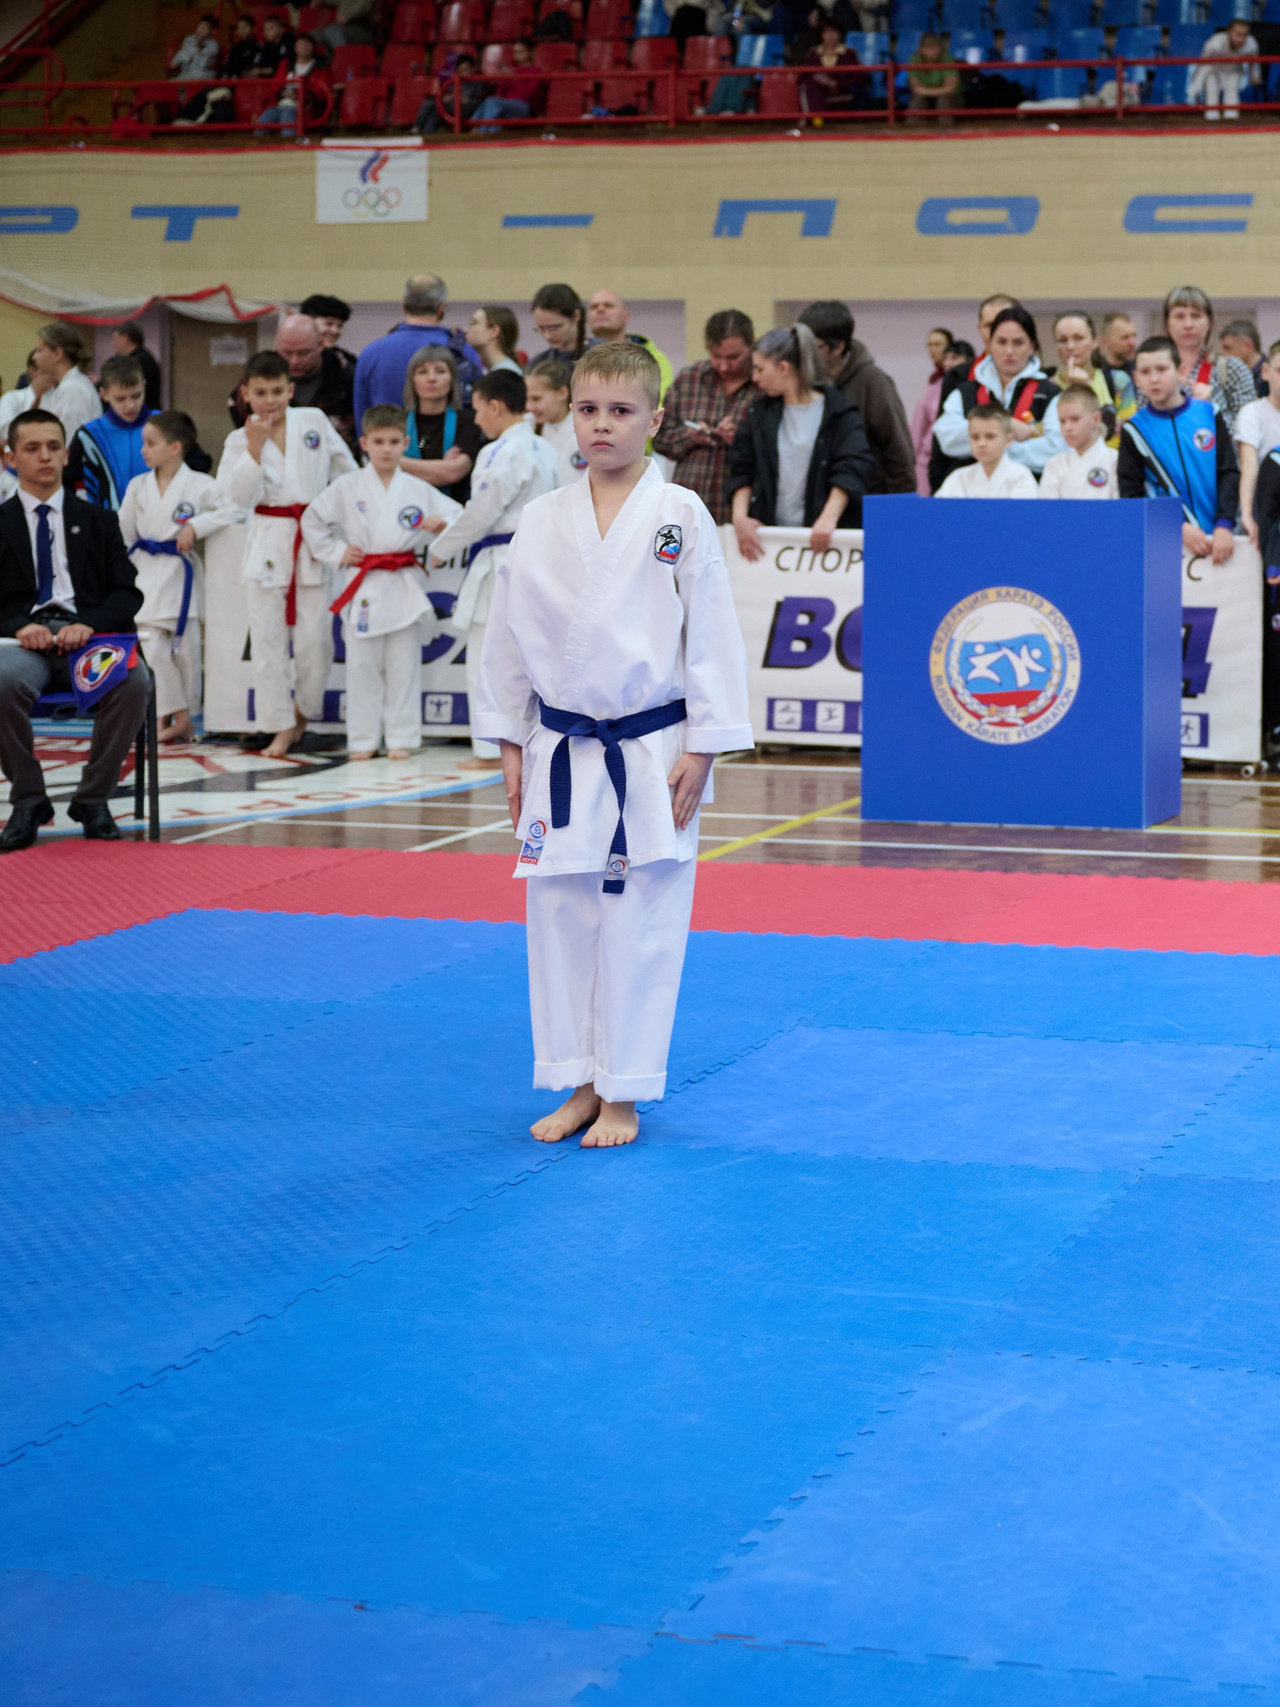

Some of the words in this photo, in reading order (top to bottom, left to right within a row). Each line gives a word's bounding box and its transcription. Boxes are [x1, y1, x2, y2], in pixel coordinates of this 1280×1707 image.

[933, 589, 990, 655] ФЕДЕРАЦИЯ
[995, 588, 1045, 612] КАРАТЭ
[1047, 608, 1078, 662] РОССИИ
[934, 674, 964, 723] RUSSIAN
[966, 721, 1011, 742] KARATE
[1016, 687, 1074, 742] FEDERATION
